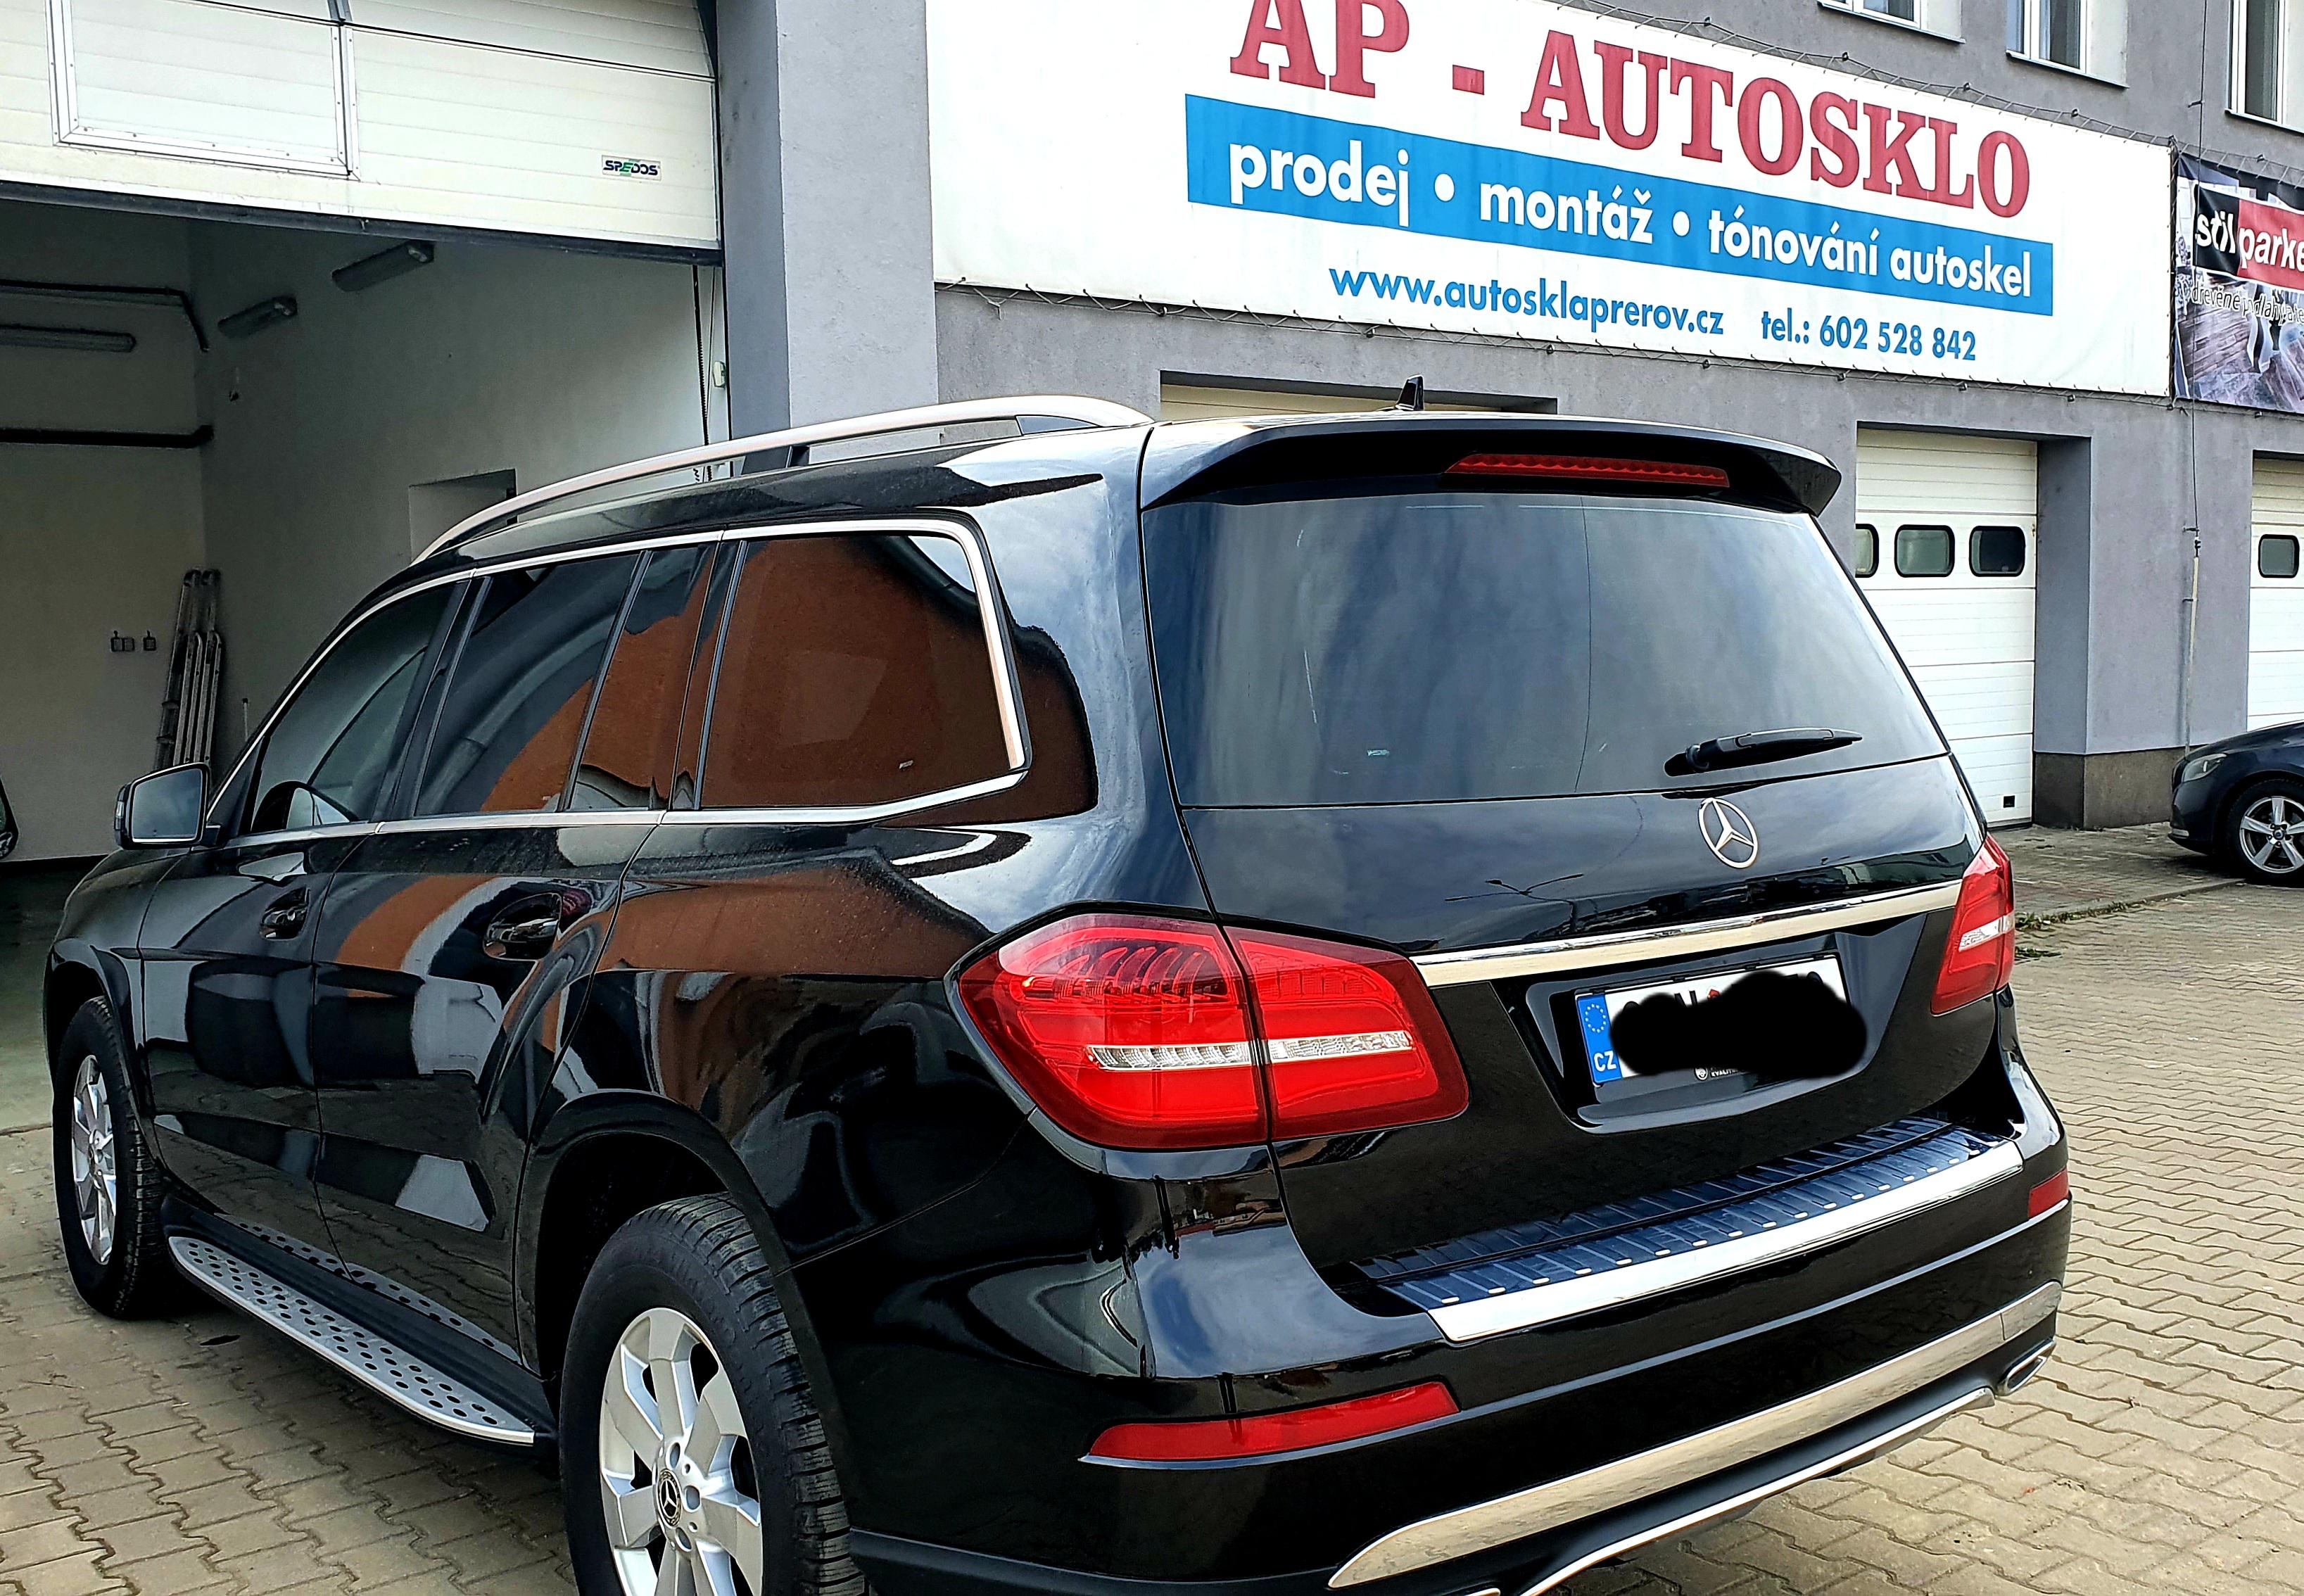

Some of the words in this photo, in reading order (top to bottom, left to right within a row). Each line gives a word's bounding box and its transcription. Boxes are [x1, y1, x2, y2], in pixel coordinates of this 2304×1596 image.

[1230, 0, 1410, 99] AP
[1521, 30, 2030, 218] AUTOSKLO
[603, 160, 658, 176] SPEDOS
[1229, 140, 1409, 227] prodej
[1480, 184, 1654, 244] montáž
[1709, 205, 1880, 276] tónování
[1890, 246, 2031, 298] autoskel
[1329, 268, 1723, 336] www.autosklaprerov.cz
[1761, 311, 1810, 344] tel.:
[1820, 315, 1868, 350] 602
[1878, 322, 1923, 356] 528
[1932, 327, 1976, 361] 842
[1594, 1050, 1616, 1072] CZ
